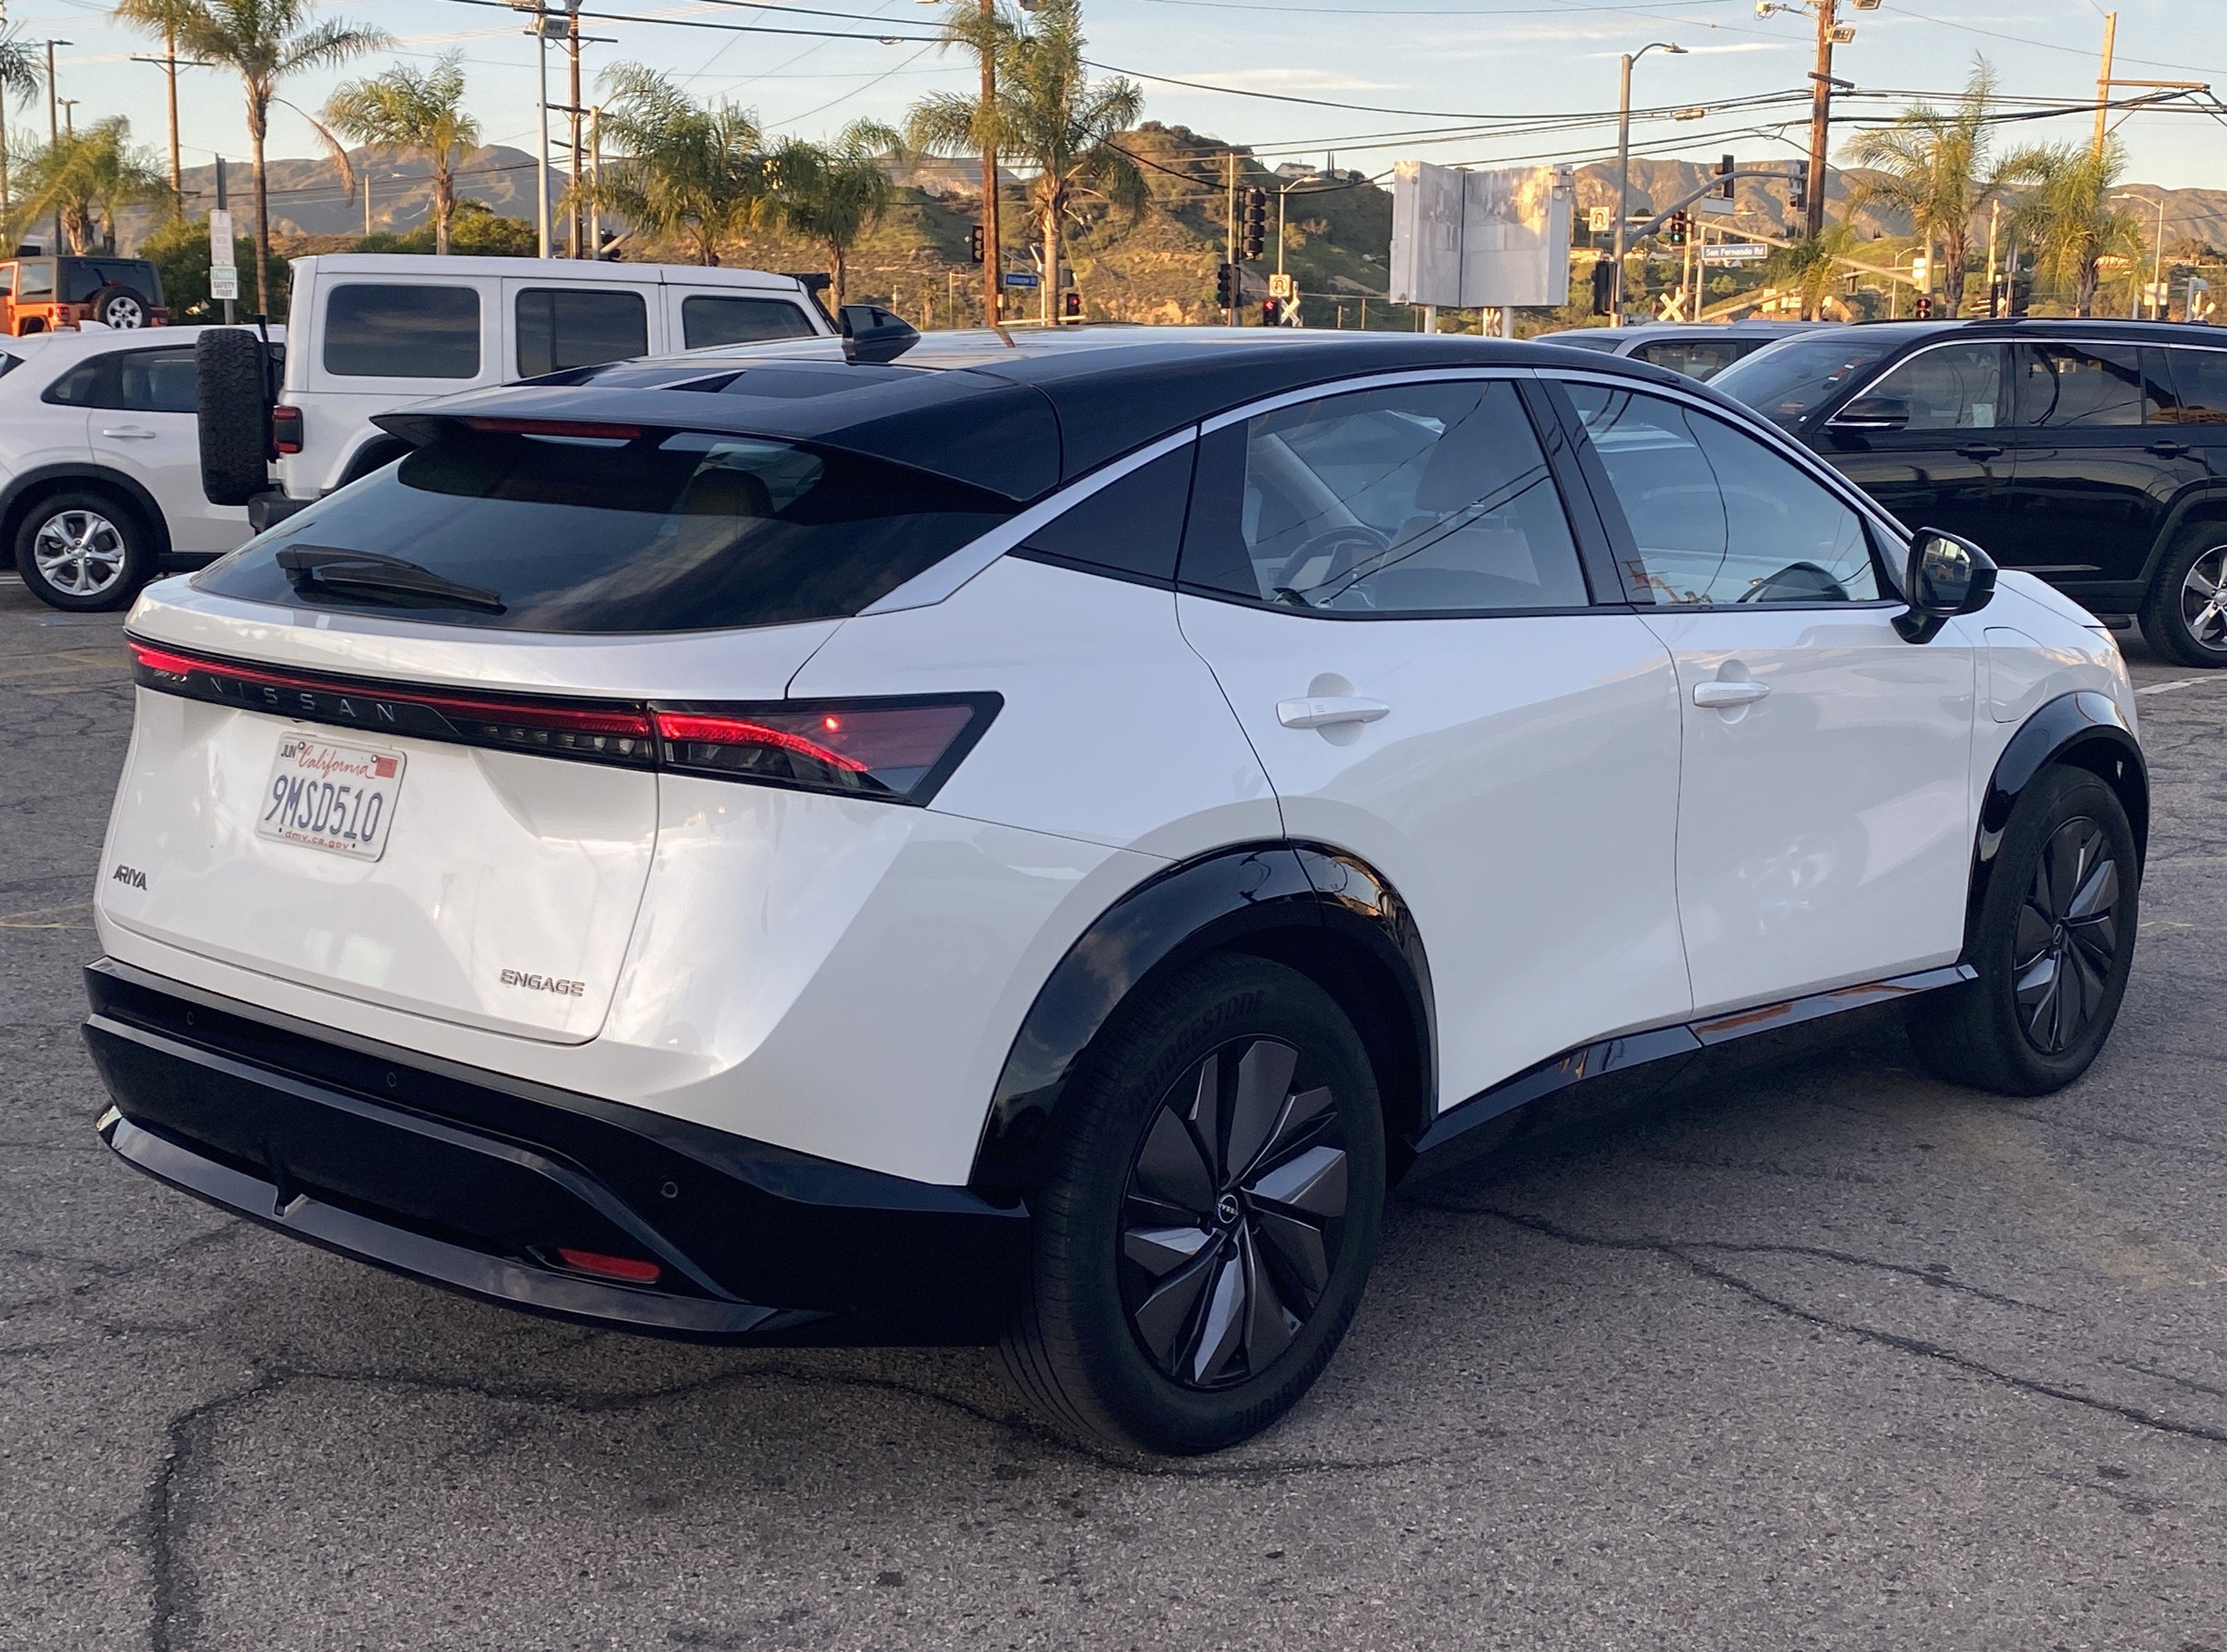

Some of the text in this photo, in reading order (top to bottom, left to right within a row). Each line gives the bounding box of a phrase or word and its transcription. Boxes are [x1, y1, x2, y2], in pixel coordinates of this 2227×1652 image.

[1705, 248, 1719, 256] San
[1754, 246, 1764, 255] Rd
[210, 676, 396, 723] NISSAN
[281, 744, 297, 758] JUN
[298, 744, 375, 779] California
[265, 774, 383, 842] 9MSD510
[284, 829, 349, 849] dmv.ca.gov
[113, 864, 147, 891] ARIYA
[500, 968, 585, 997] ENGAGE
